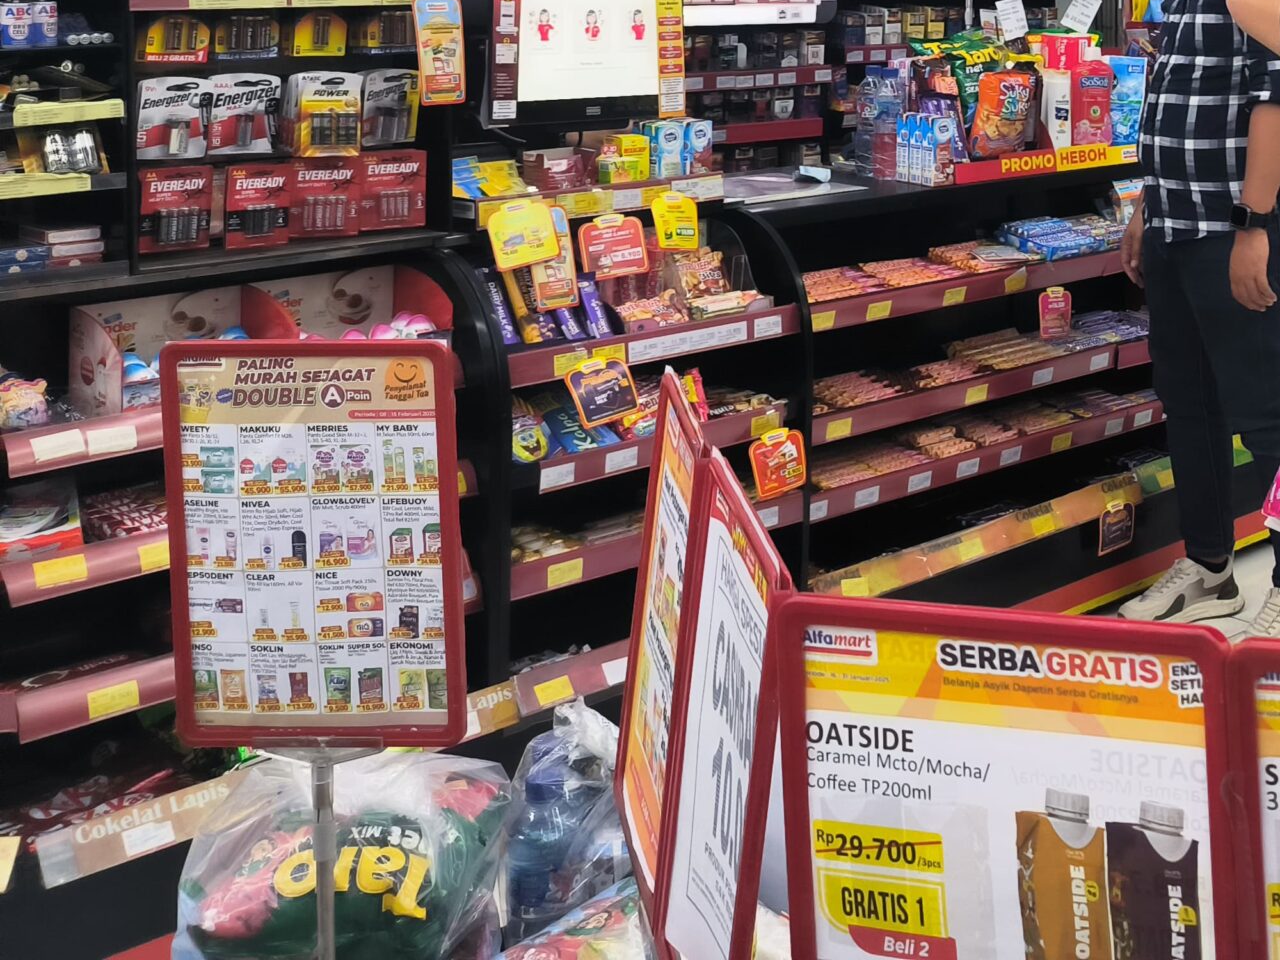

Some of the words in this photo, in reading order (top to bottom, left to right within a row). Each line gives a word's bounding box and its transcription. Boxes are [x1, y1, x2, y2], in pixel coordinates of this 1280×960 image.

[5, 7, 31, 17] ABC
[170, 54, 195, 62] GRATIS
[196, 50, 204, 62] 1
[966, 63, 983, 74] net
[1082, 77, 1109, 88] SoSoft
[213, 84, 280, 108] Energizer
[312, 89, 349, 97] POWER
[142, 93, 192, 110] Energizer
[1001, 154, 1054, 173] PROMO
[1060, 149, 1108, 165] HEBOH
[298, 169, 353, 182] EVEREADY
[367, 162, 420, 176] EVEREADY
[150, 179, 206, 193] EVEREADY
[236, 176, 285, 190] EVEREADY
[496, 304, 509, 326] MILK
[237, 357, 294, 371] PALING
[234, 371, 298, 385] MURAH
[301, 368, 375, 383] SEJAGAT
[384, 381, 426, 393] Penyelamat
[232, 387, 316, 407] DOUBLE
[324, 386, 342, 403] A
[347, 391, 370, 400] Poin
[385, 392, 414, 402] Tanggal
[416, 390, 429, 398] Tua
[556, 409, 598, 451] Kalpa
[184, 499, 219, 507] ASELINE
[322, 558, 348, 566] 16.900
[187, 572, 234, 580] EPSODENT
[246, 573, 275, 581] CLEAR
[387, 569, 422, 577] DOWNY
[390, 642, 434, 650] EKONOMI
[803, 629, 872, 649] Alfamart
[191, 643, 213, 651] INSO
[250, 645, 284, 653] SOKLIN
[939, 642, 1041, 674] SERBA
[1046, 651, 1159, 683] GRATIS
[943, 676, 980, 690] Belanja
[982, 679, 1009, 692] Asyik
[1013, 682, 1053, 697] Dapetin
[1056, 686, 1086, 699] Serba
[1089, 690, 1138, 704] Gratisnya
[806, 720, 915, 753] OATSIDE
[806, 744, 871, 769] Caramel
[875, 753, 990, 782] Mcto/Mocha/
[806, 771, 857, 794] Coffee
[862, 778, 932, 801] TP200ml
[75, 802, 168, 844] Cokelat
[170, 782, 230, 818] Lapis
[272, 845, 430, 921] Taro
[840, 885, 910, 924] GRATIS
[915, 897, 926, 926] 1
[1069, 865, 1091, 960] OATSIDE
[1167, 884, 1186, 960] ATSIDE
[883, 934, 917, 956] Beli
[918, 941, 929, 956] 2
